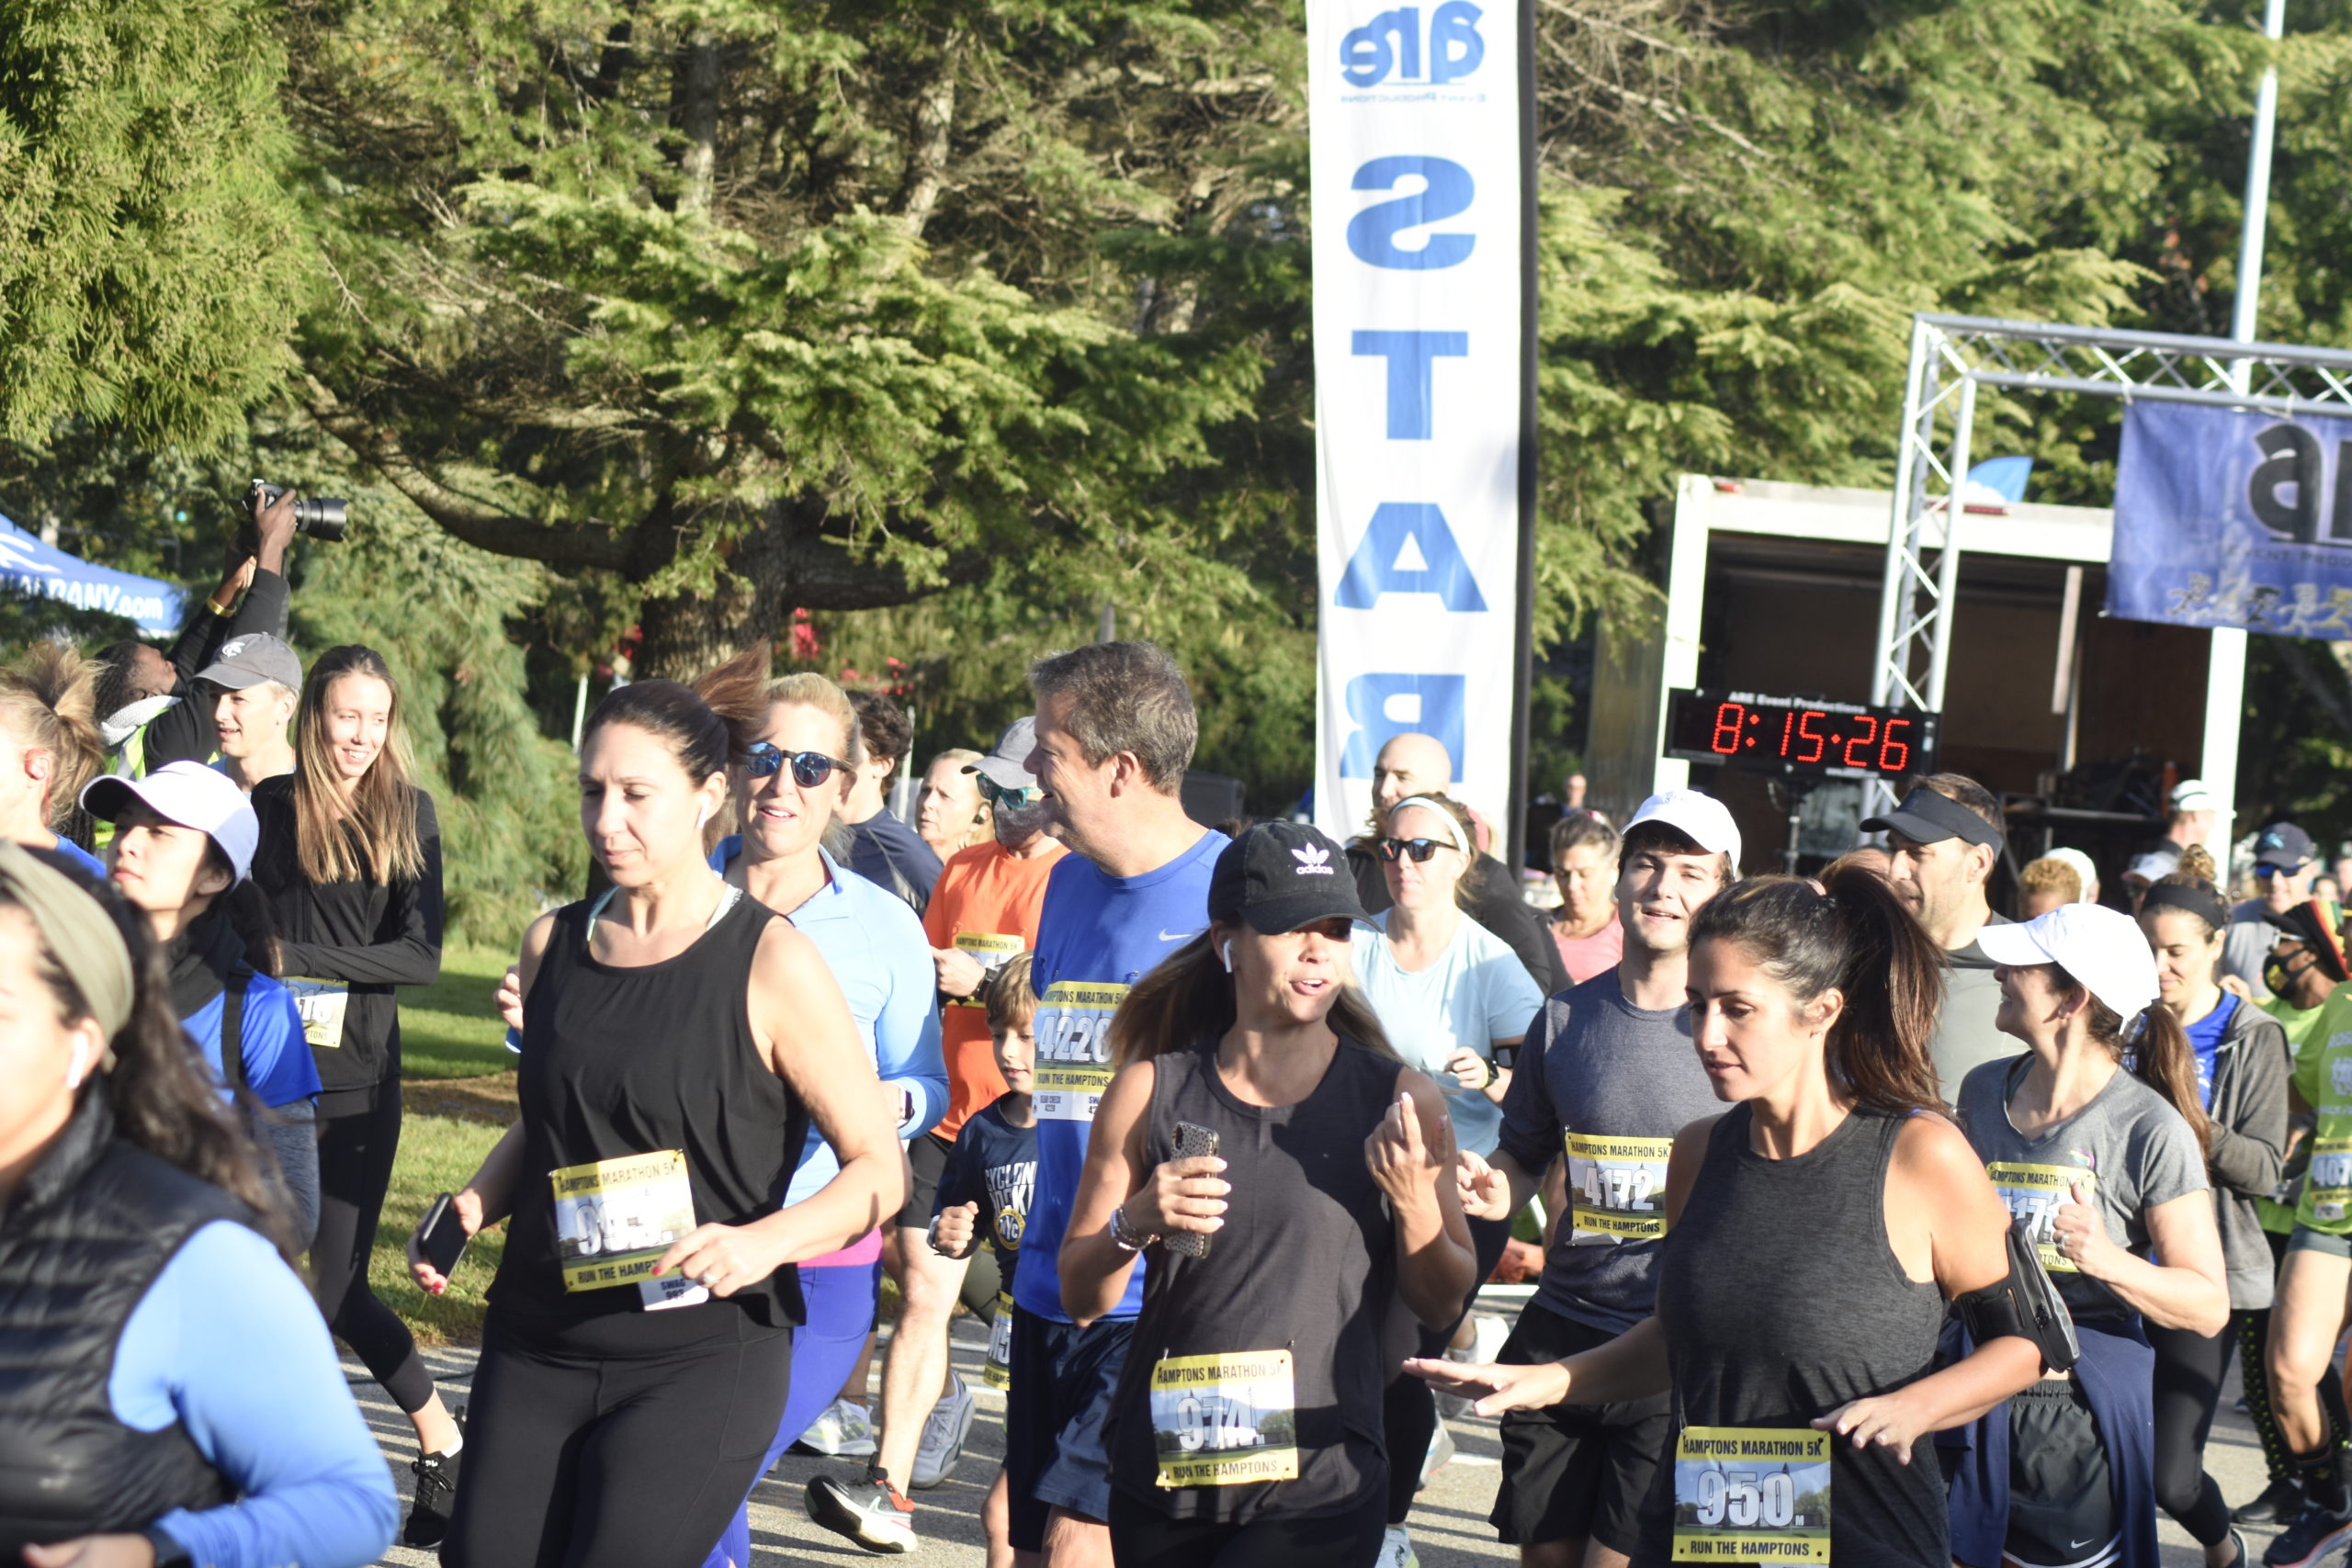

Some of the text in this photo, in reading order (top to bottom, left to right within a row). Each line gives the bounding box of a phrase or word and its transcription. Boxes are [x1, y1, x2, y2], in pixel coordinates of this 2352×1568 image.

[1728, 691, 1867, 715] ARE Event Productions
[1296, 863, 1334, 875] adidas
[1076, 991, 1113, 1005] MARATHON
[1037, 1073, 1110, 1088] RUN THE HAMPTONS
[1571, 1142, 1668, 1158] HAMPTONS MARATHON 5K
[560, 1161, 678, 1194] HAMPTONS MARATHON 5K
[985, 1161, 1038, 1192] CYCLON
[1584, 1166, 1655, 1211] 4172
[1584, 1215, 1660, 1234] RUN THE HAMPTONS
[578, 1269, 596, 1285] RUN
[598, 1266, 616, 1281] THE
[1157, 1366, 1205, 1384] HAMPTONS
[1208, 1364, 1266, 1381] MARATHON
[1683, 1438, 1822, 1457] HAMPTONS MARATHON 5K
[1172, 1460, 1278, 1479] RUN THE HAMPTONS
[1690, 1540, 1810, 1557] RUN THE HAMPTONS
